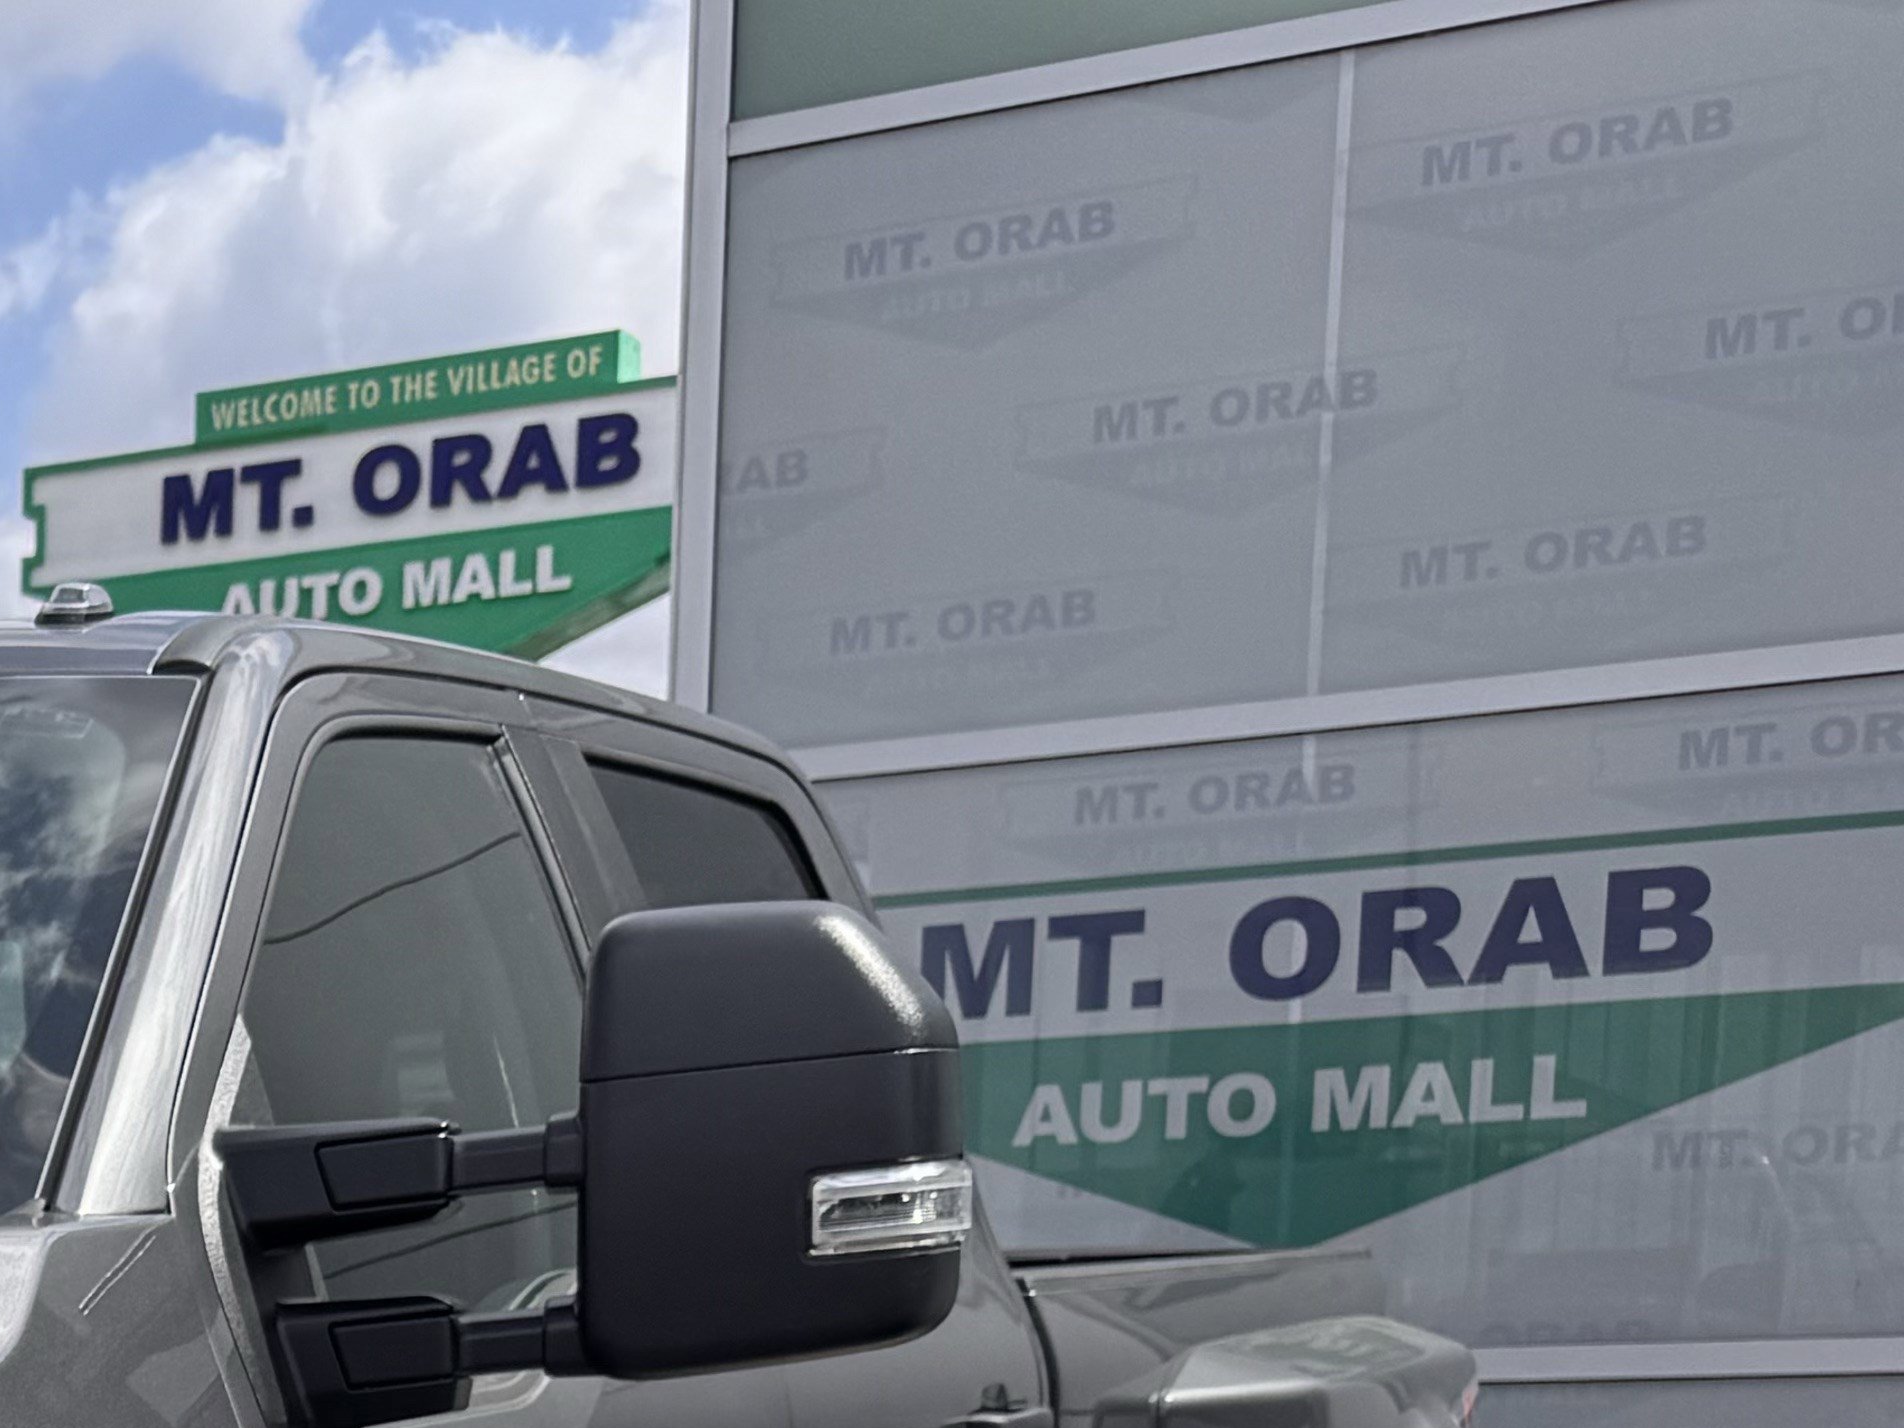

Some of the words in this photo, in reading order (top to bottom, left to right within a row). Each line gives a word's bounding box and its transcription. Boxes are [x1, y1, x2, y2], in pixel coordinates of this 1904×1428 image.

[1420, 132, 1523, 188] MT.
[1547, 97, 1735, 166] ORAB
[842, 231, 933, 281] MT.
[953, 200, 1117, 262] ORAB
[1704, 306, 1812, 360] MT.
[210, 378, 338, 431] WELCOME
[346, 376, 382, 410] TO
[389, 366, 438, 406] THE
[445, 349, 559, 400] VILLAGE
[566, 343, 604, 378] OF
[1092, 395, 1188, 445] MT.
[1207, 368, 1379, 430] ORAB
[160, 456, 314, 545] MT.
[352, 411, 641, 517] ORAB
[222, 570, 384, 621] AUTO
[400, 545, 573, 611] MALL
[1398, 540, 1501, 590] MT.
[1522, 514, 1708, 575] ORAB
[829, 609, 919, 656] MT.
[936, 587, 1097, 643] ORAB
[1676, 722, 1783, 772] MT.
[1073, 781, 1166, 828] MT.
[1190, 762, 1358, 816] ORAB
[921, 908, 1164, 1020] MT.
[1229, 864, 1715, 1001] ORAB
[1012, 1072, 1277, 1148] AUTO
[1310, 1055, 1588, 1133] MALL
